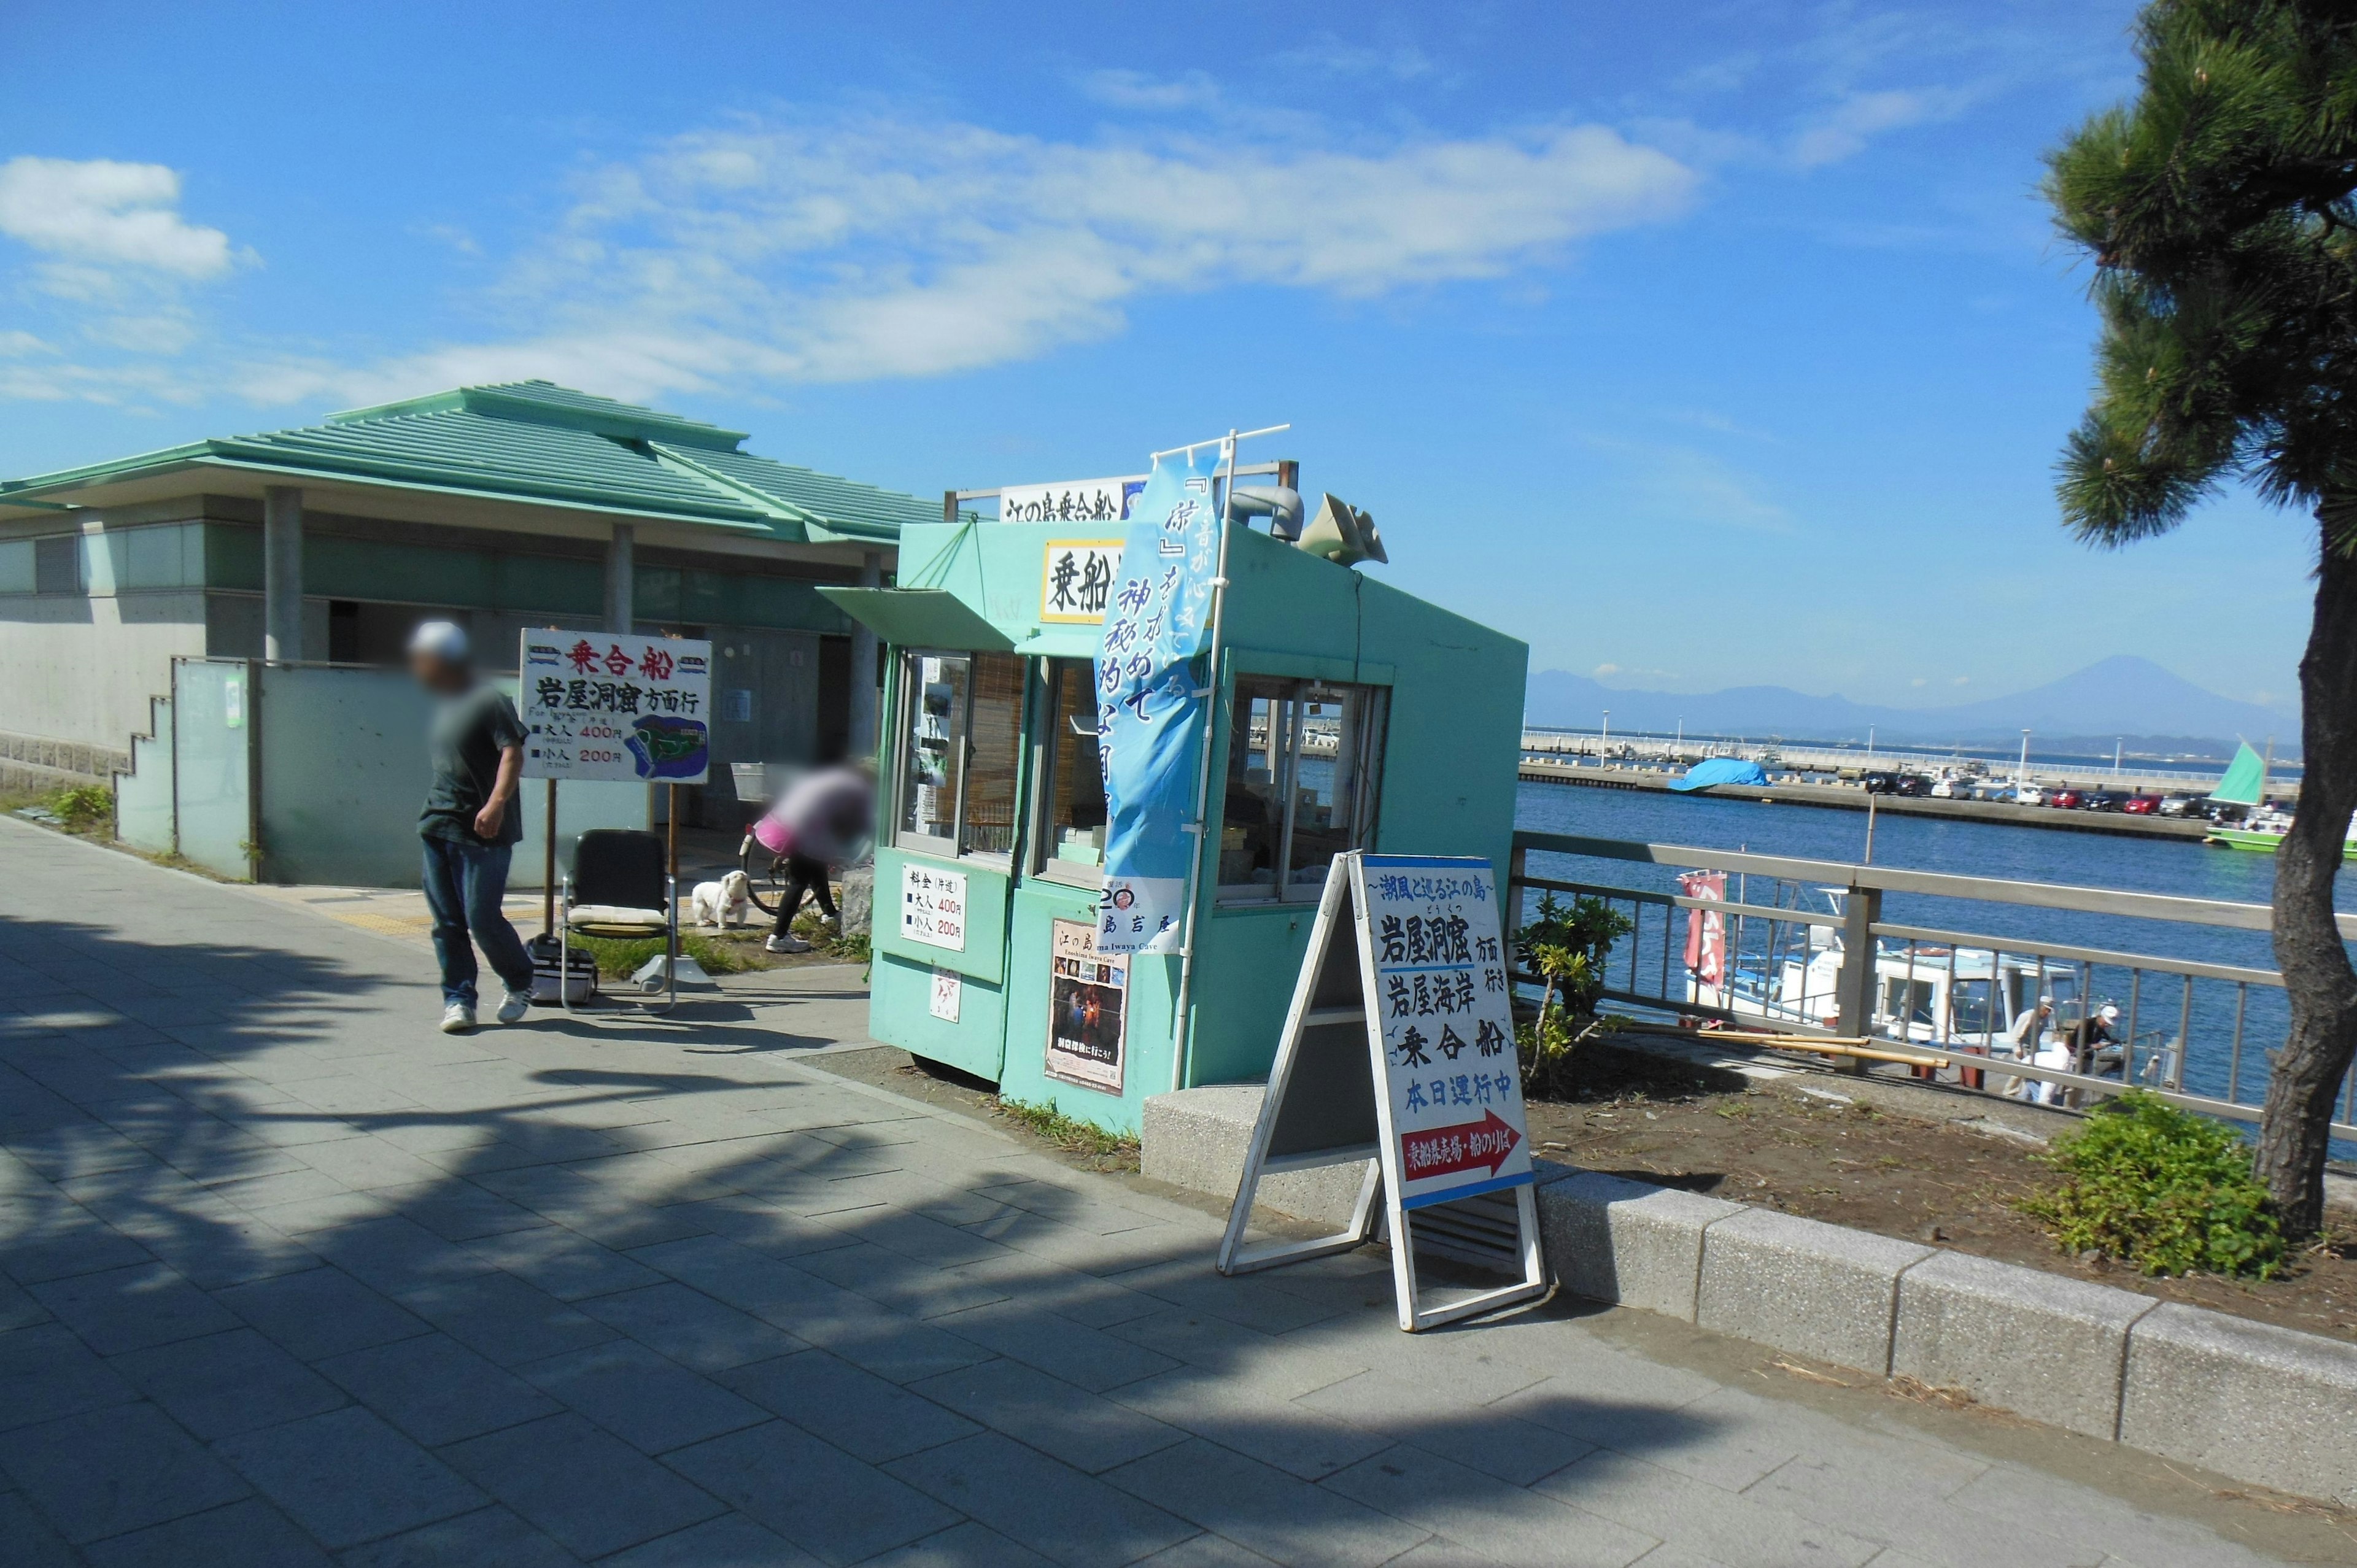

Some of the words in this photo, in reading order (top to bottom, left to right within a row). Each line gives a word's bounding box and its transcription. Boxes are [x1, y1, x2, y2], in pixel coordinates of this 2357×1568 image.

[1005, 489, 1117, 522] 江の島乗合船
[1048, 550, 1121, 613] 乗船
[565, 639, 673, 681] 乗合船
[535, 676, 699, 714] 岩屋洞窟方面行
[1097, 578, 1151, 809] 神秘的な
[544, 724, 573, 736] 大人
[579, 726, 621, 739] 400円
[543, 747, 570, 761] 小人
[579, 749, 621, 762] 200円
[910, 871, 931, 889] 料金
[915, 893, 933, 910] 大人
[938, 898, 961, 915] 400円
[1427, 903, 1462, 914] どうくつ
[914, 915, 932, 932] 小人
[938, 919, 961, 938] 200円
[1380, 914, 1473, 965] 岩屋洞窟
[1065, 949, 1088, 959] Enoshima
[1089, 953, 1102, 963] Iwaya
[1387, 971, 1475, 1018] 岩屋海岸
[1398, 1019, 1505, 1068] 乗合船
[1406, 1070, 1511, 1114] 本日運行中
